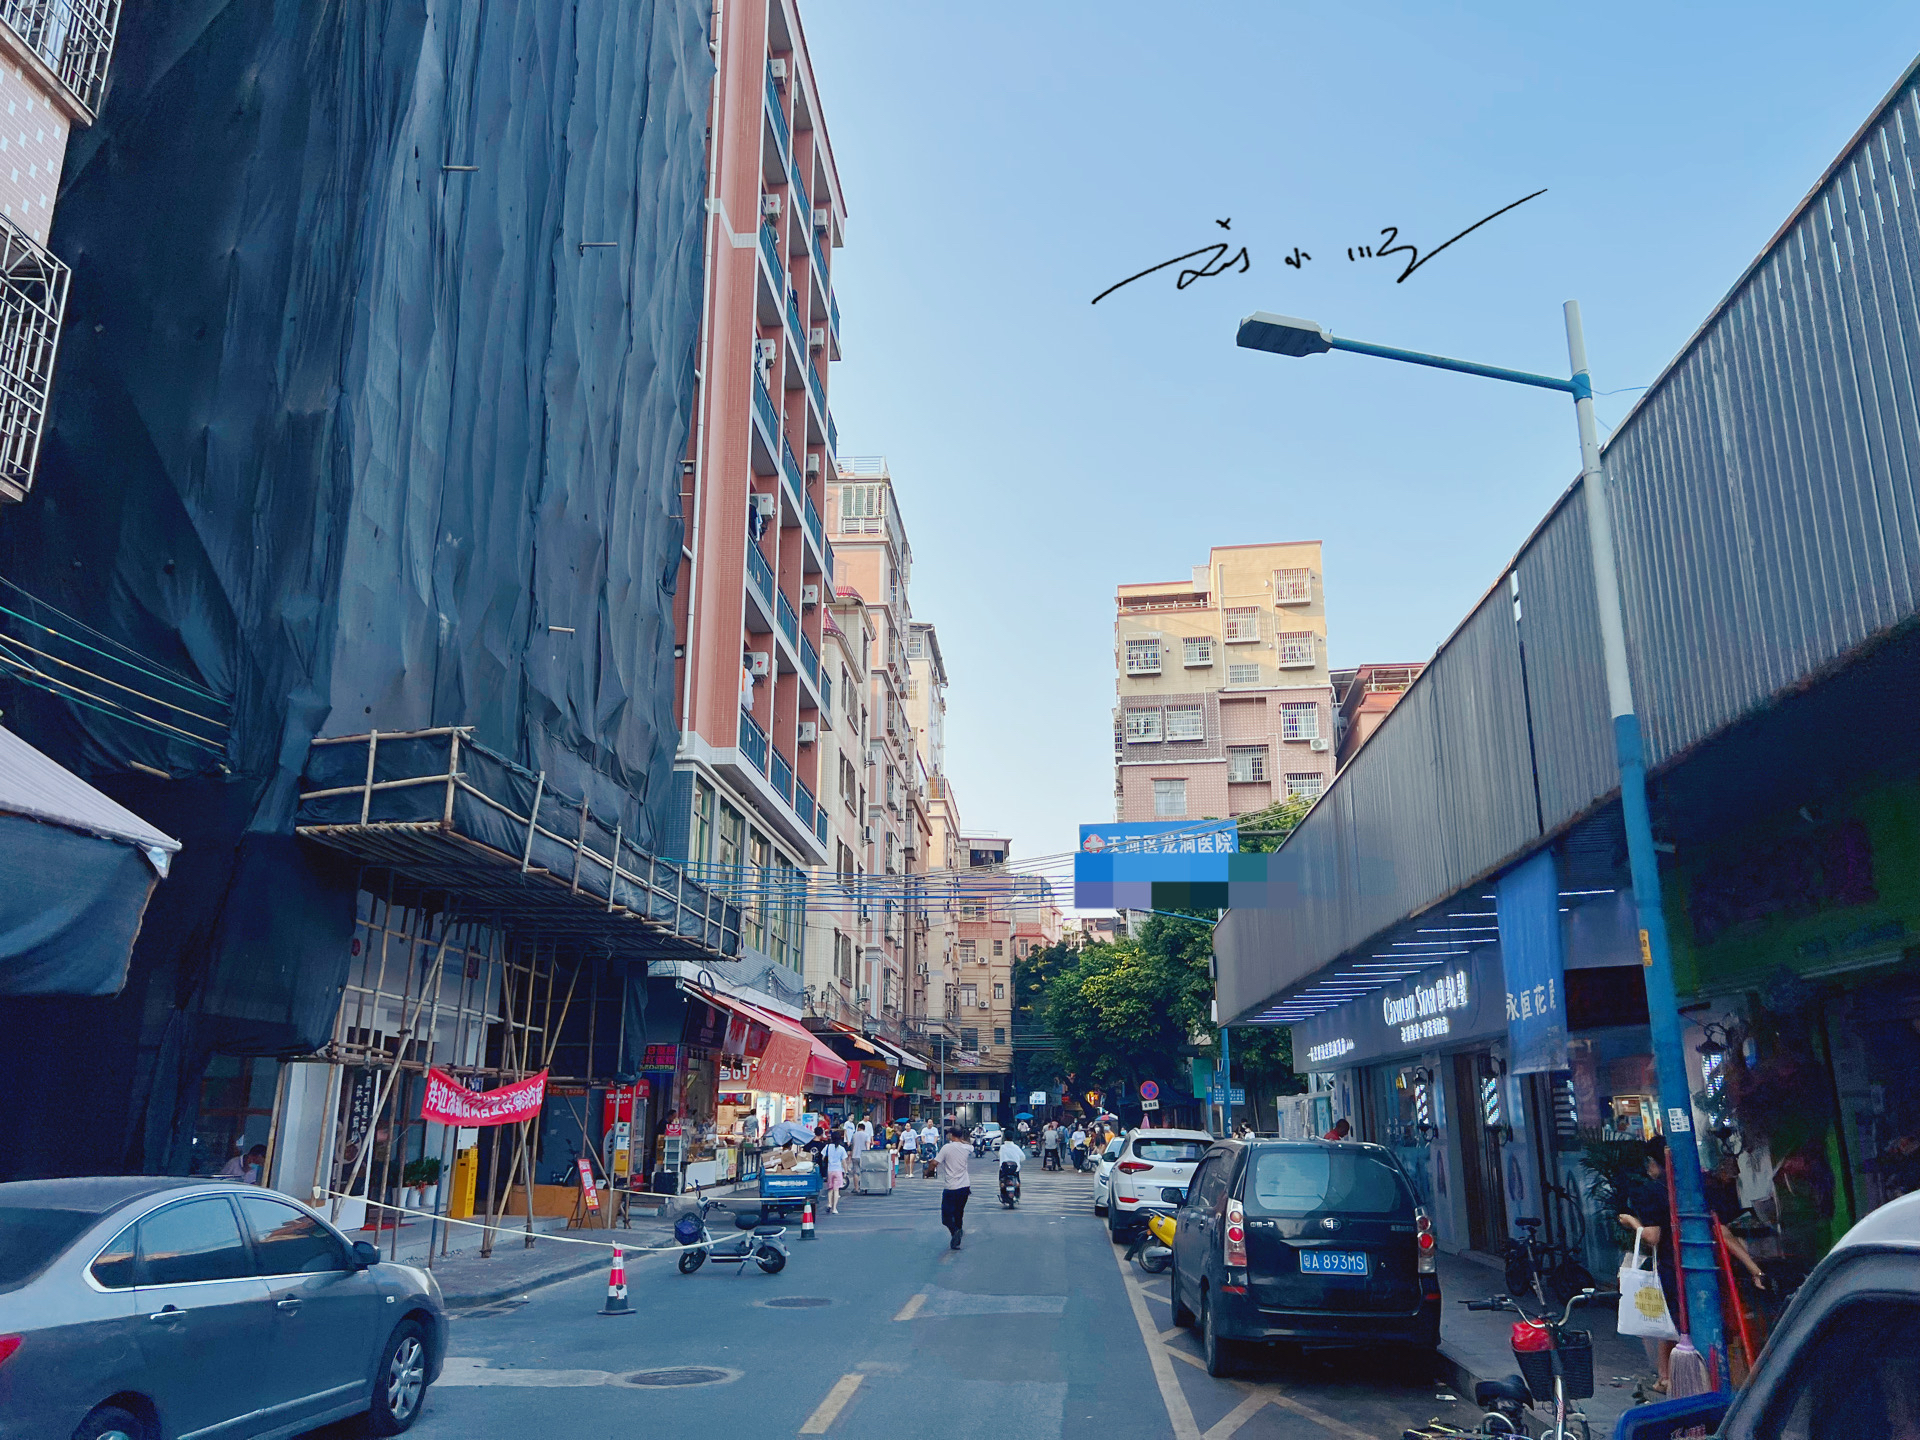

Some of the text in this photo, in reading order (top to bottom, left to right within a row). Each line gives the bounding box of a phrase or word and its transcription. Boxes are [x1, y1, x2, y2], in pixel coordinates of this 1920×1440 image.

[1107, 833, 1234, 854] 天河区龙洞医院
[945, 1091, 985, 1101] 重庆小面
